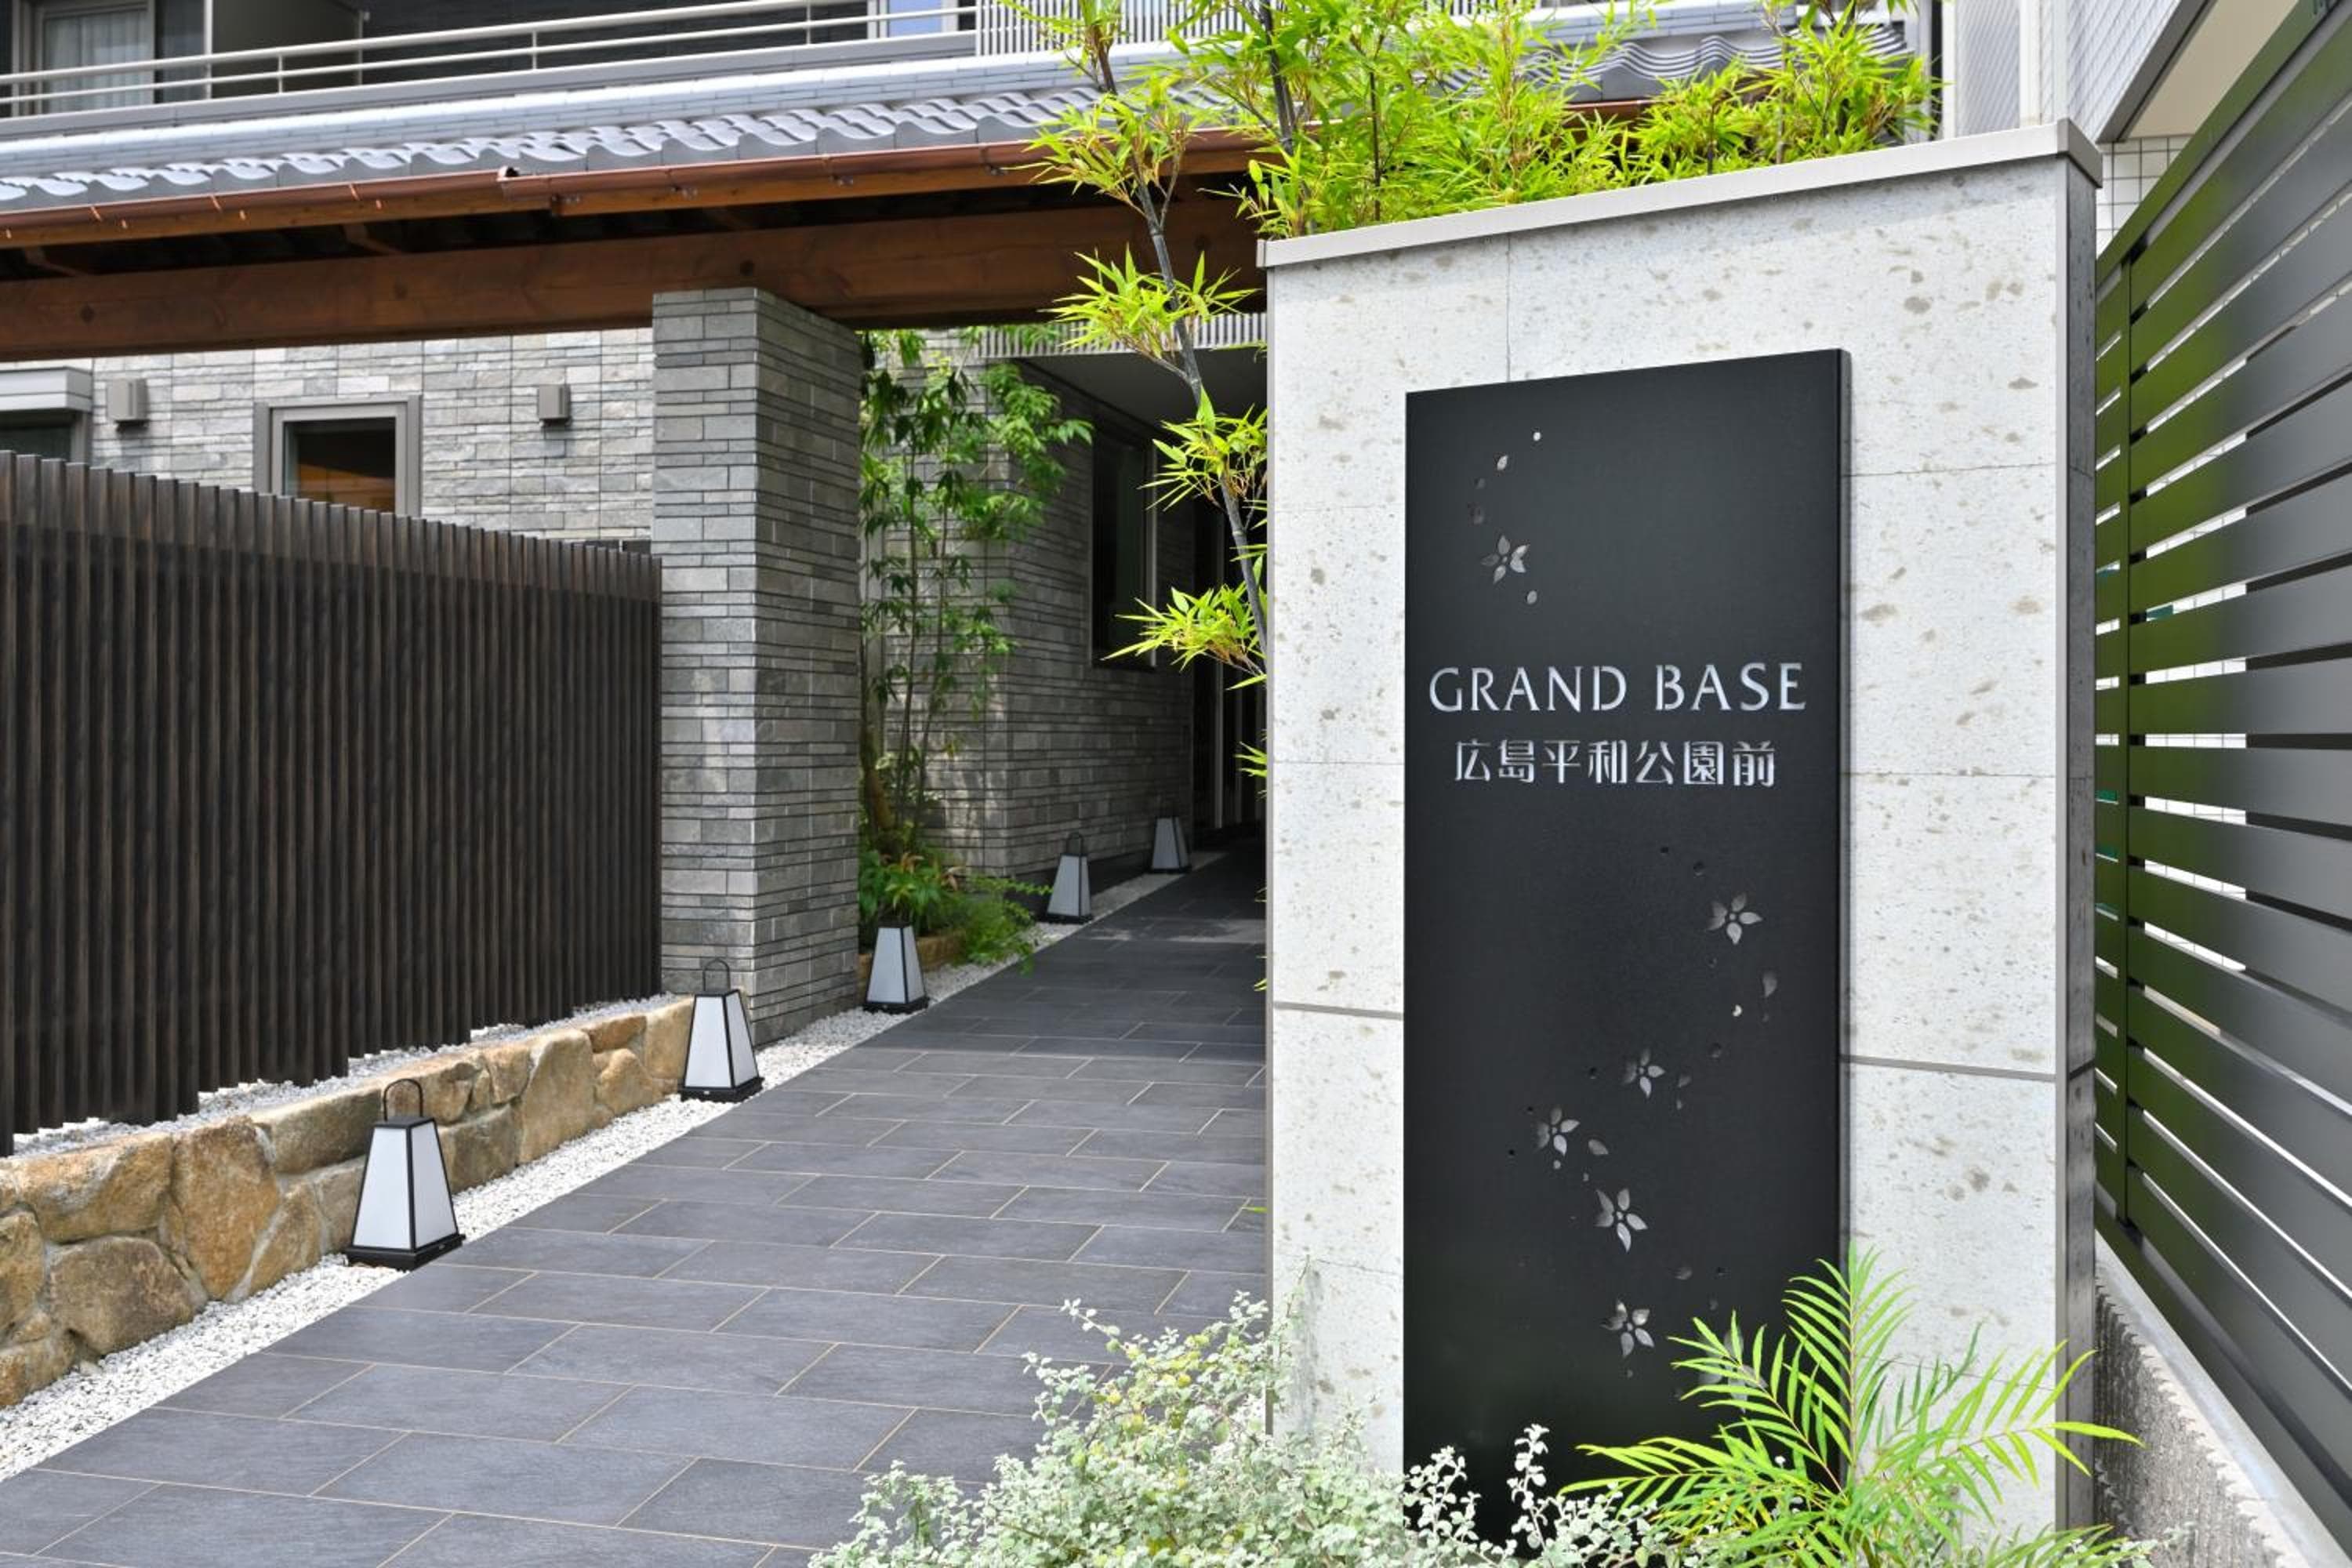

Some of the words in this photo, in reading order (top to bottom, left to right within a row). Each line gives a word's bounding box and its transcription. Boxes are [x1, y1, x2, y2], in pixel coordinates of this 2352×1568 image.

[1428, 666, 1628, 713] GRAND
[1654, 662, 1806, 712] BASE
[1454, 739, 1777, 788] 広島平和公園前
